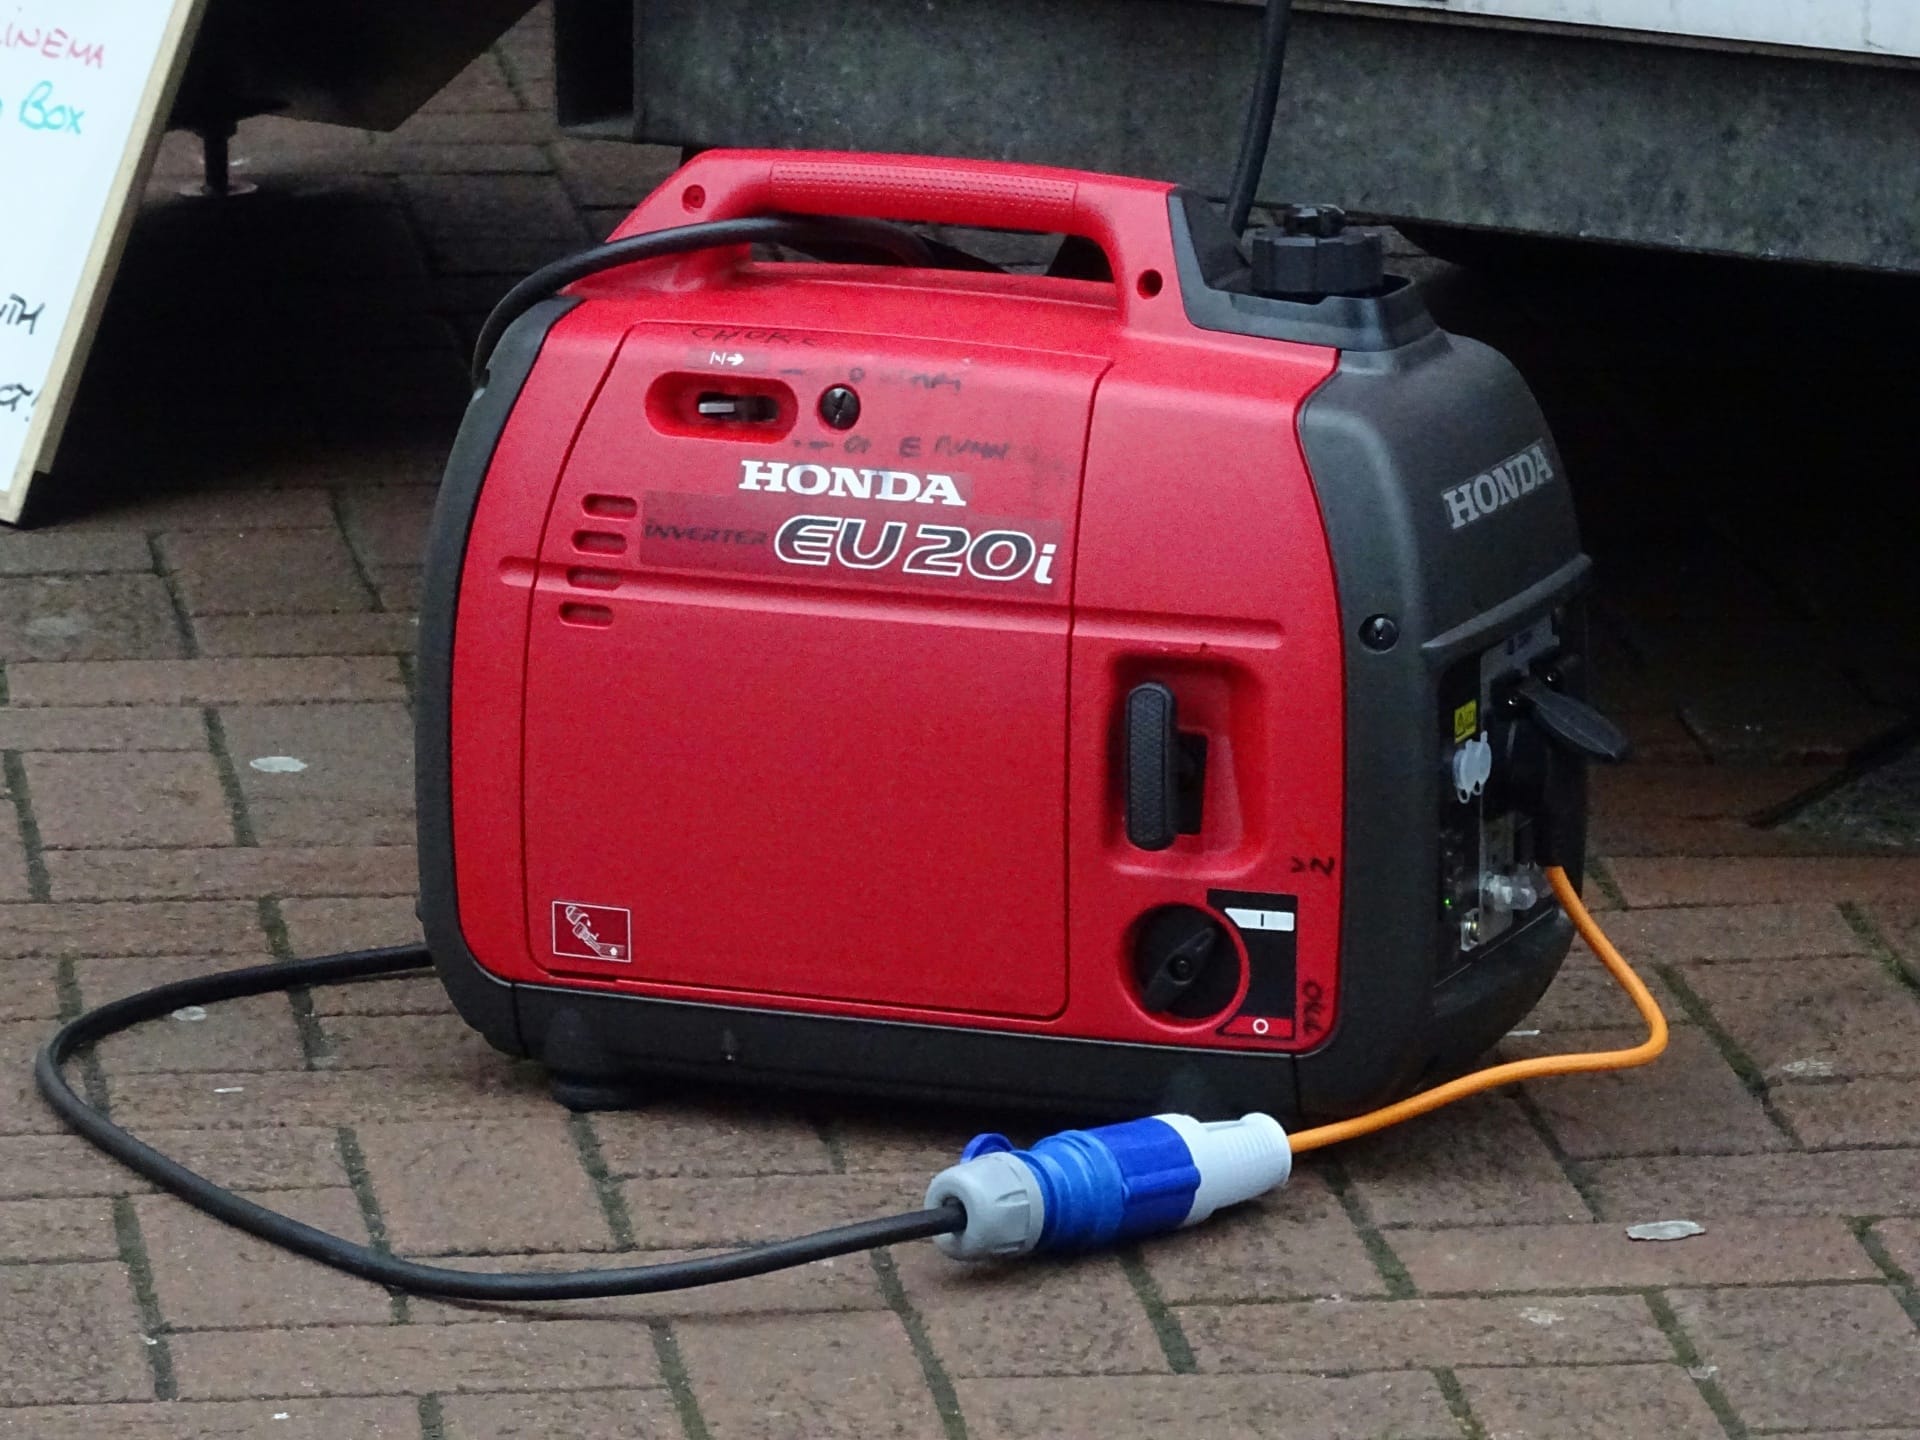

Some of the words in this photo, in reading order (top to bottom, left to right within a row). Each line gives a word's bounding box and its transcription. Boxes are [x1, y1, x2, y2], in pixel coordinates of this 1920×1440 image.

[0, 21, 104, 69] INEMA
[739, 460, 967, 506] HONDA
[1443, 446, 1553, 529] HONDA
